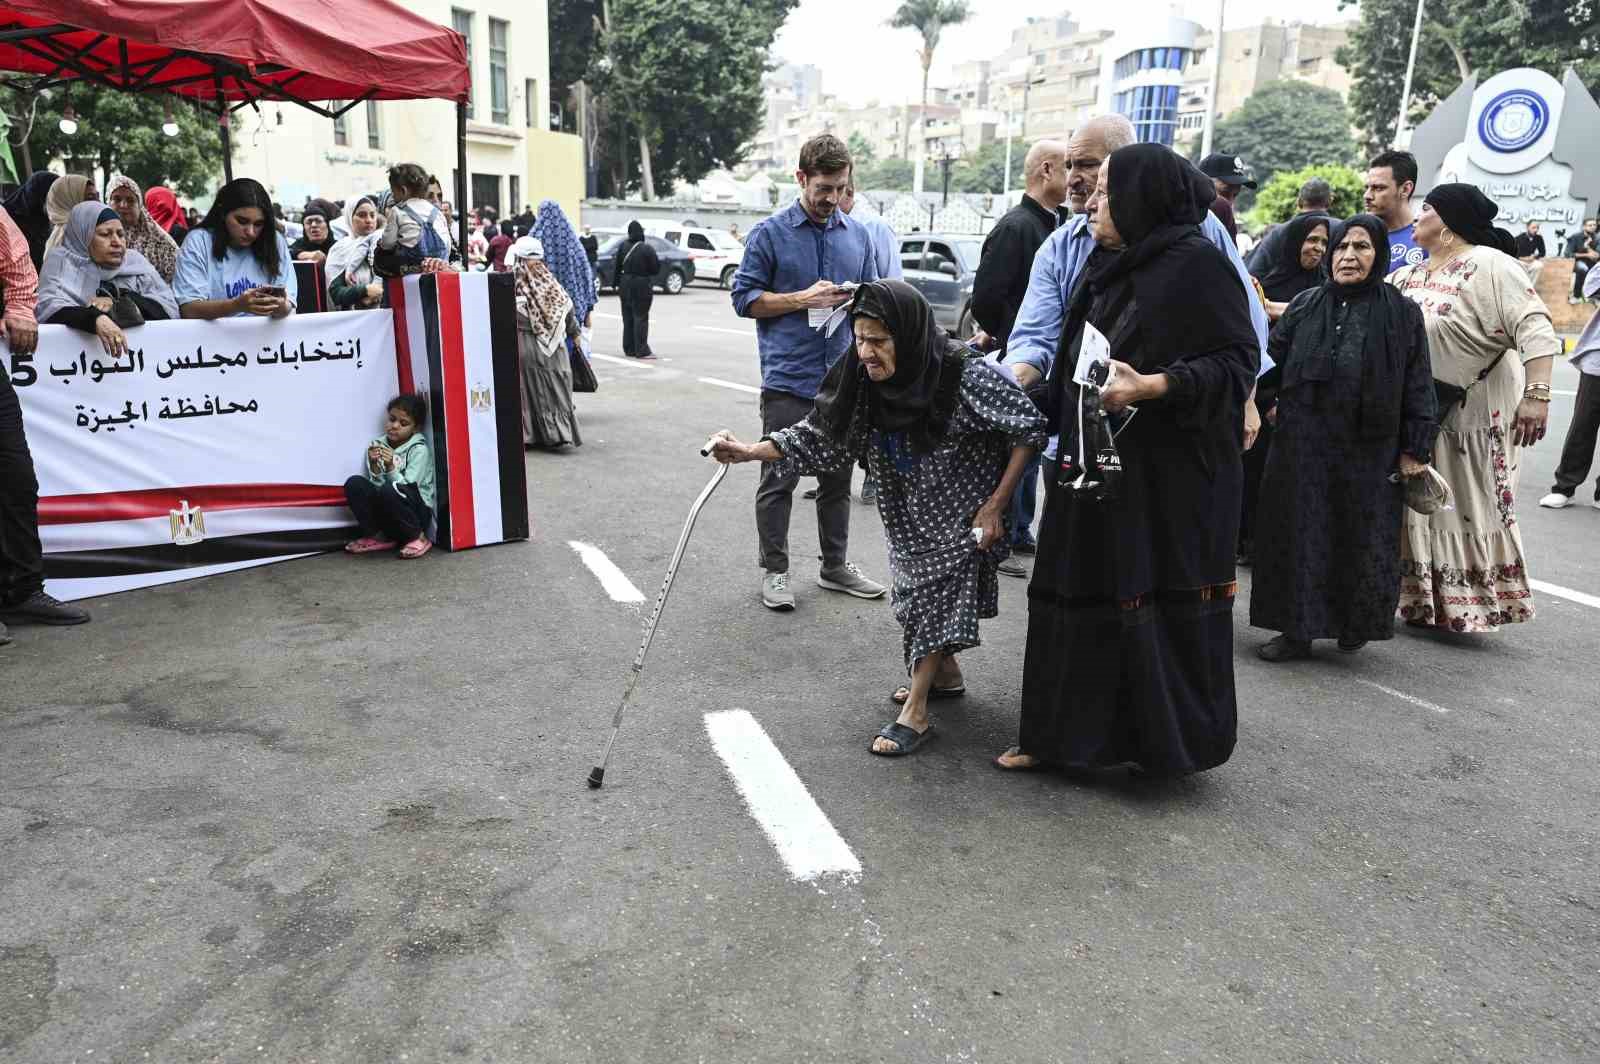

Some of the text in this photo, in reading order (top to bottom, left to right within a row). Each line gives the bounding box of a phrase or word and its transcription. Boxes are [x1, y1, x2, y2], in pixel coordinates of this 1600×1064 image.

[50, 348, 145, 384] النواب
[156, 345, 248, 379] مجلس
[257, 338, 363, 369] إنتخابات
[76, 394, 258, 432] محافظة الجيزة
